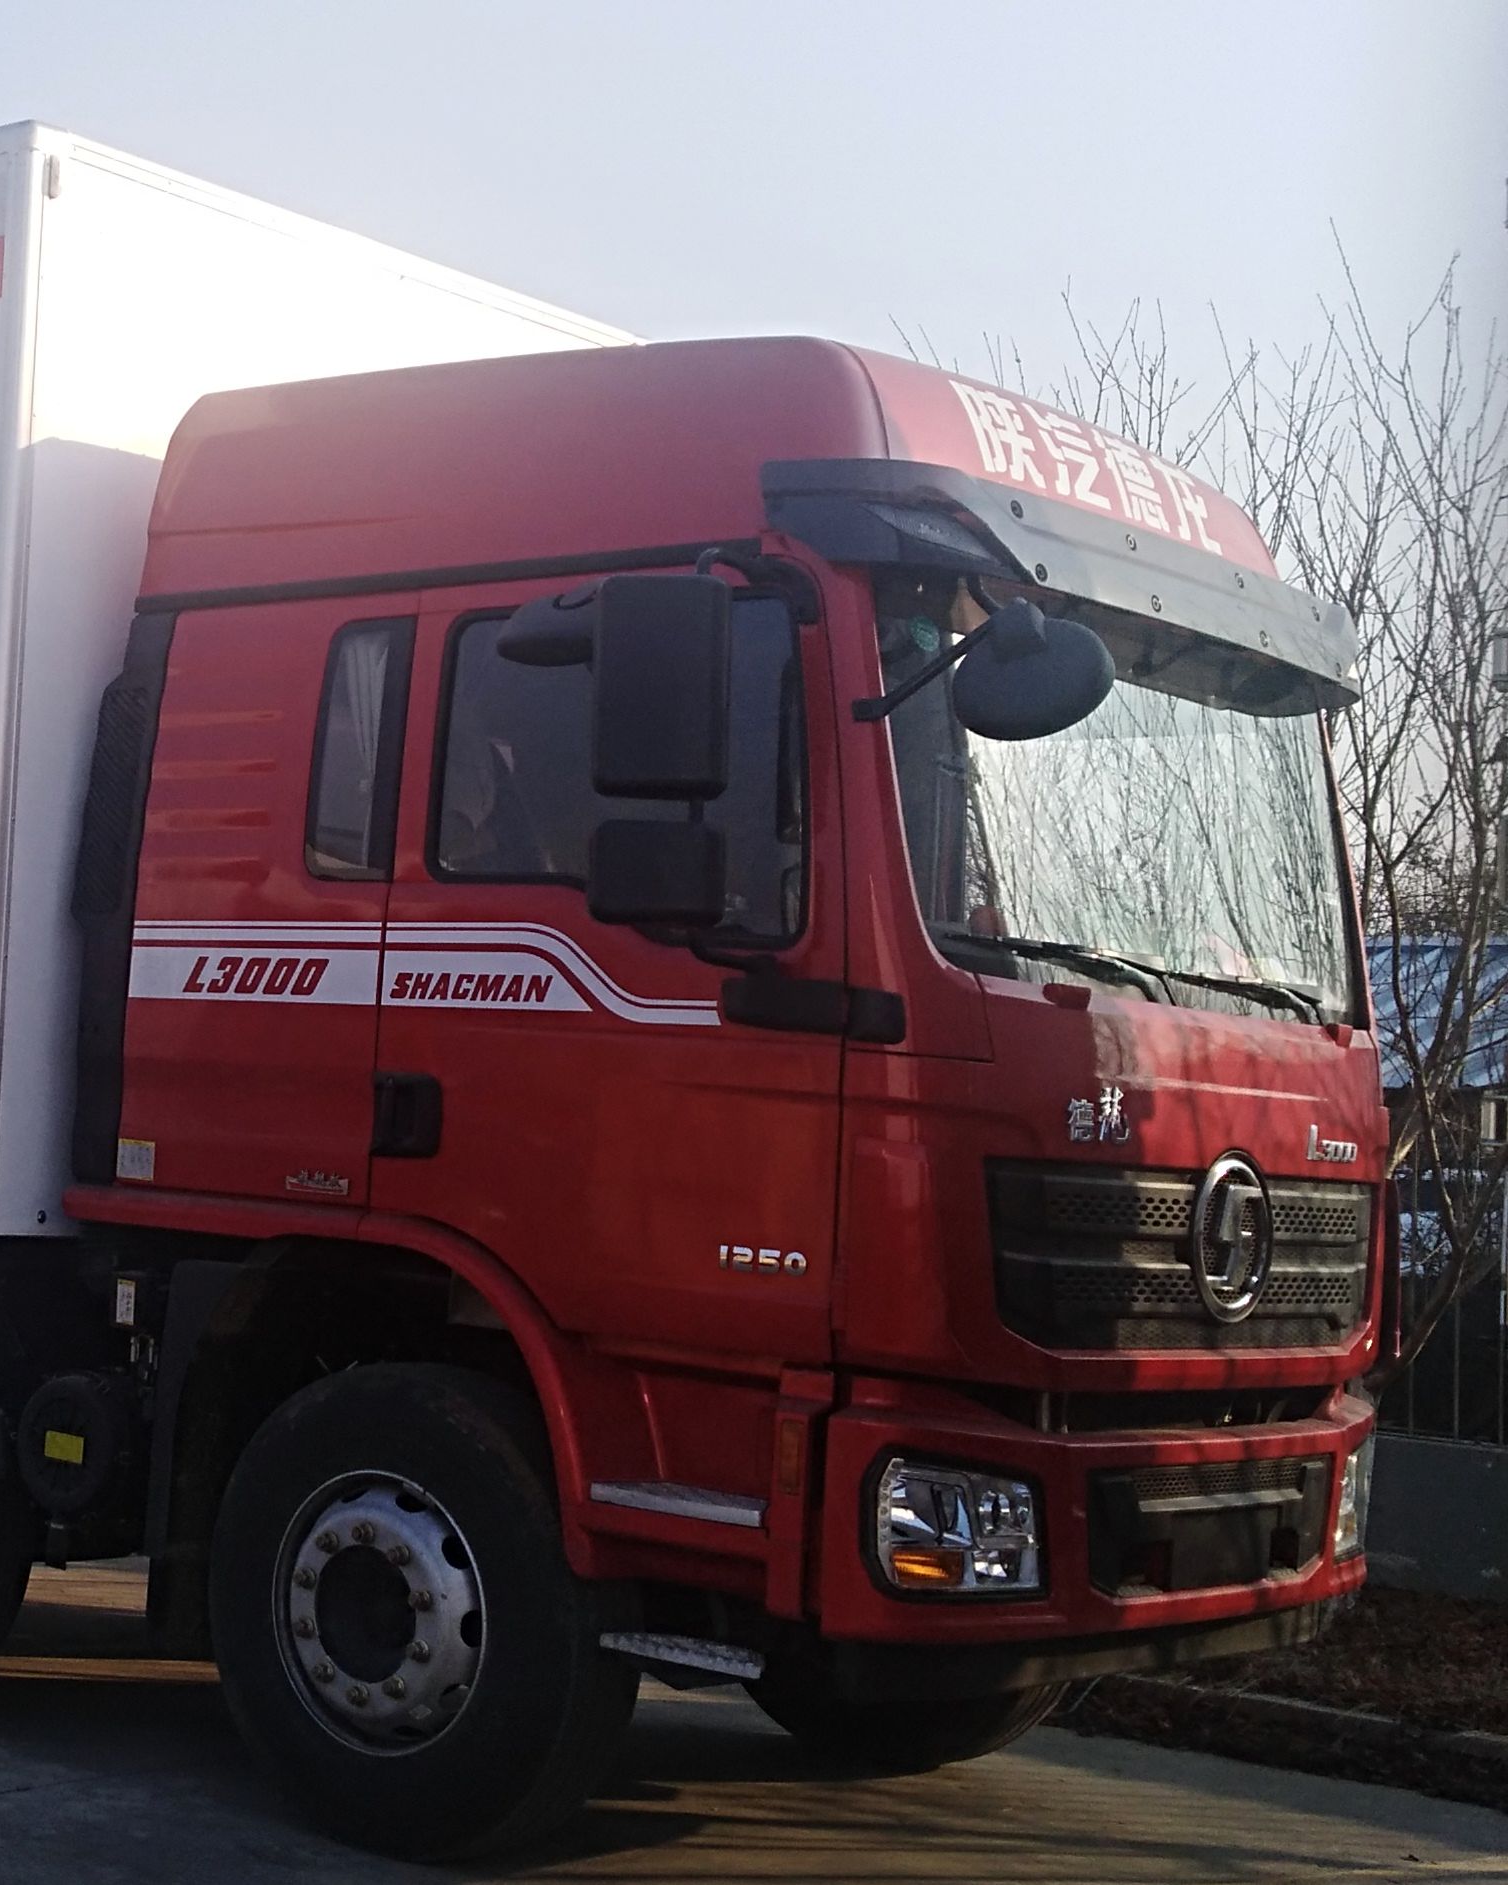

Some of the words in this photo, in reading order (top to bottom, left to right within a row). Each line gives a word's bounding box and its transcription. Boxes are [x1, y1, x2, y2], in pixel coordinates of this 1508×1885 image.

[949, 380, 1222, 556] 陕汽德龙
[182, 956, 330, 996] L3000
[390, 972, 553, 1002] SHACMAN
[719, 1245, 807, 1276] 1250
